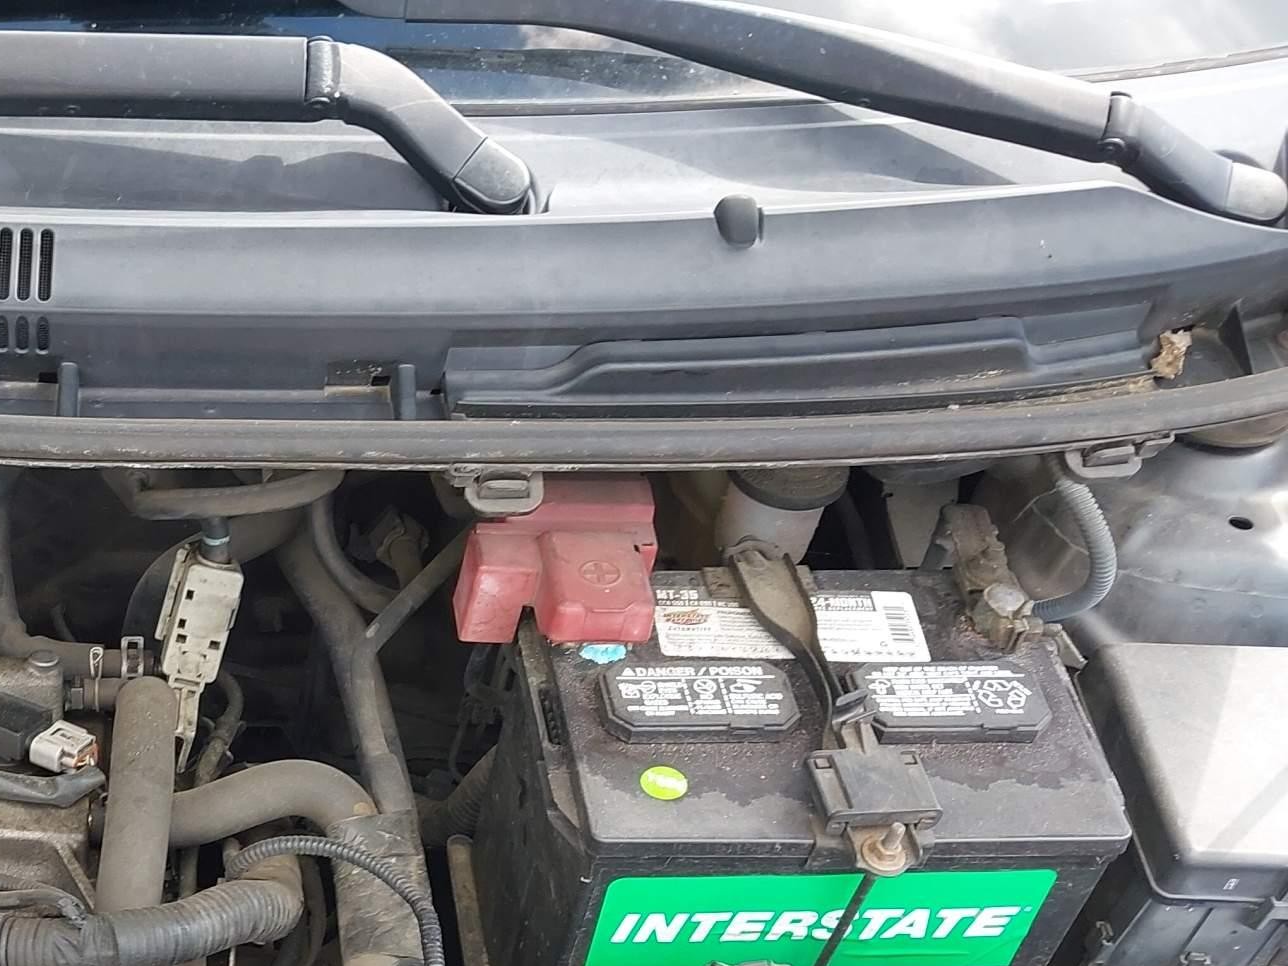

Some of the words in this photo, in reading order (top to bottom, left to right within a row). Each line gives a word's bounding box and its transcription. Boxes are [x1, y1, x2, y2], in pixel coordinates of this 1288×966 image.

[636, 667, 695, 677] DANGER
[709, 666, 764, 676] POISON
[611, 906, 1022, 944] INTERSTATE
